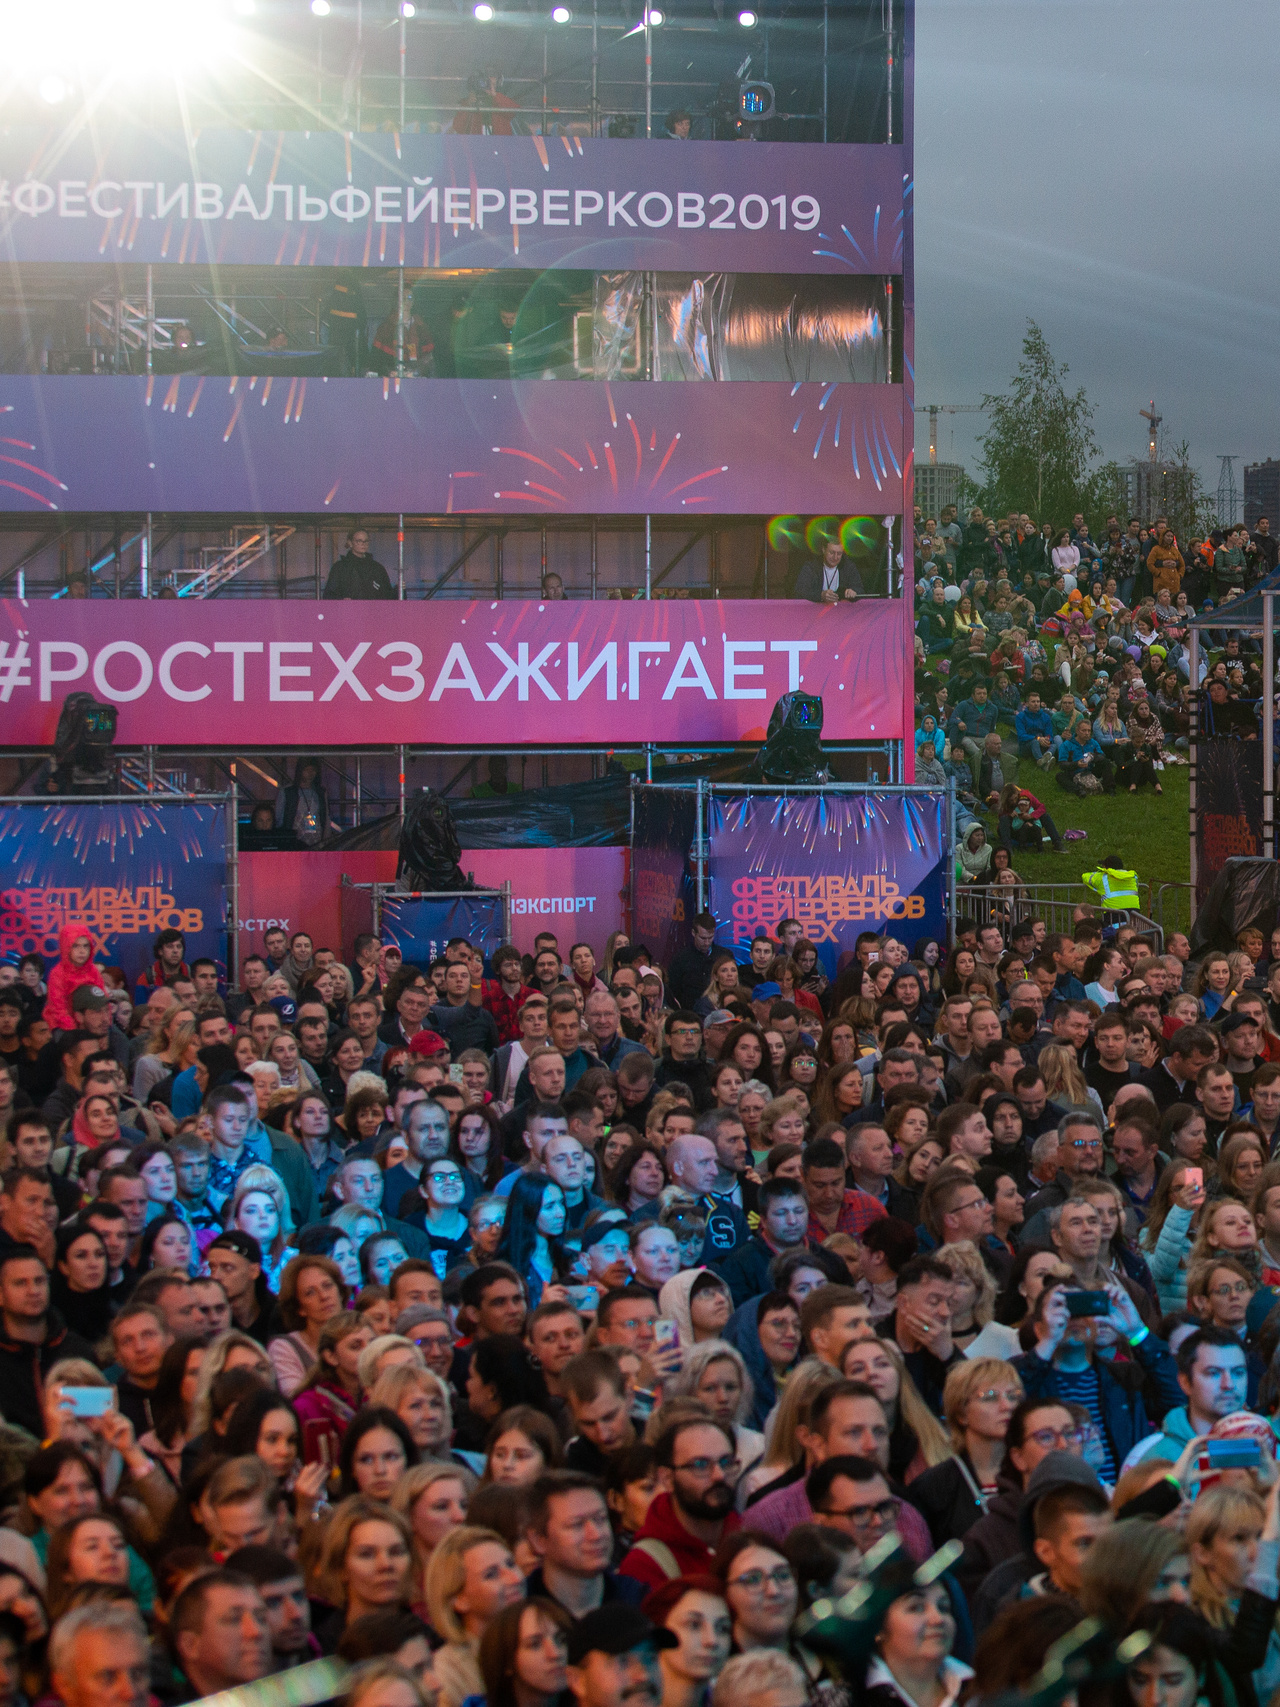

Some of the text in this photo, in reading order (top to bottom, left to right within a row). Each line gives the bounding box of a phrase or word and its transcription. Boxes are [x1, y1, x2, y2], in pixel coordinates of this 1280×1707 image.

[0, 887, 176, 911] ФЕСТИВАЛЬ
[731, 874, 900, 899] ФЕСТИВАЛЬ
[0, 905, 204, 933] ФЕЙЕРВЕРКОВ
[732, 891, 925, 921] ФЕЙЕРВЕРКОВ
